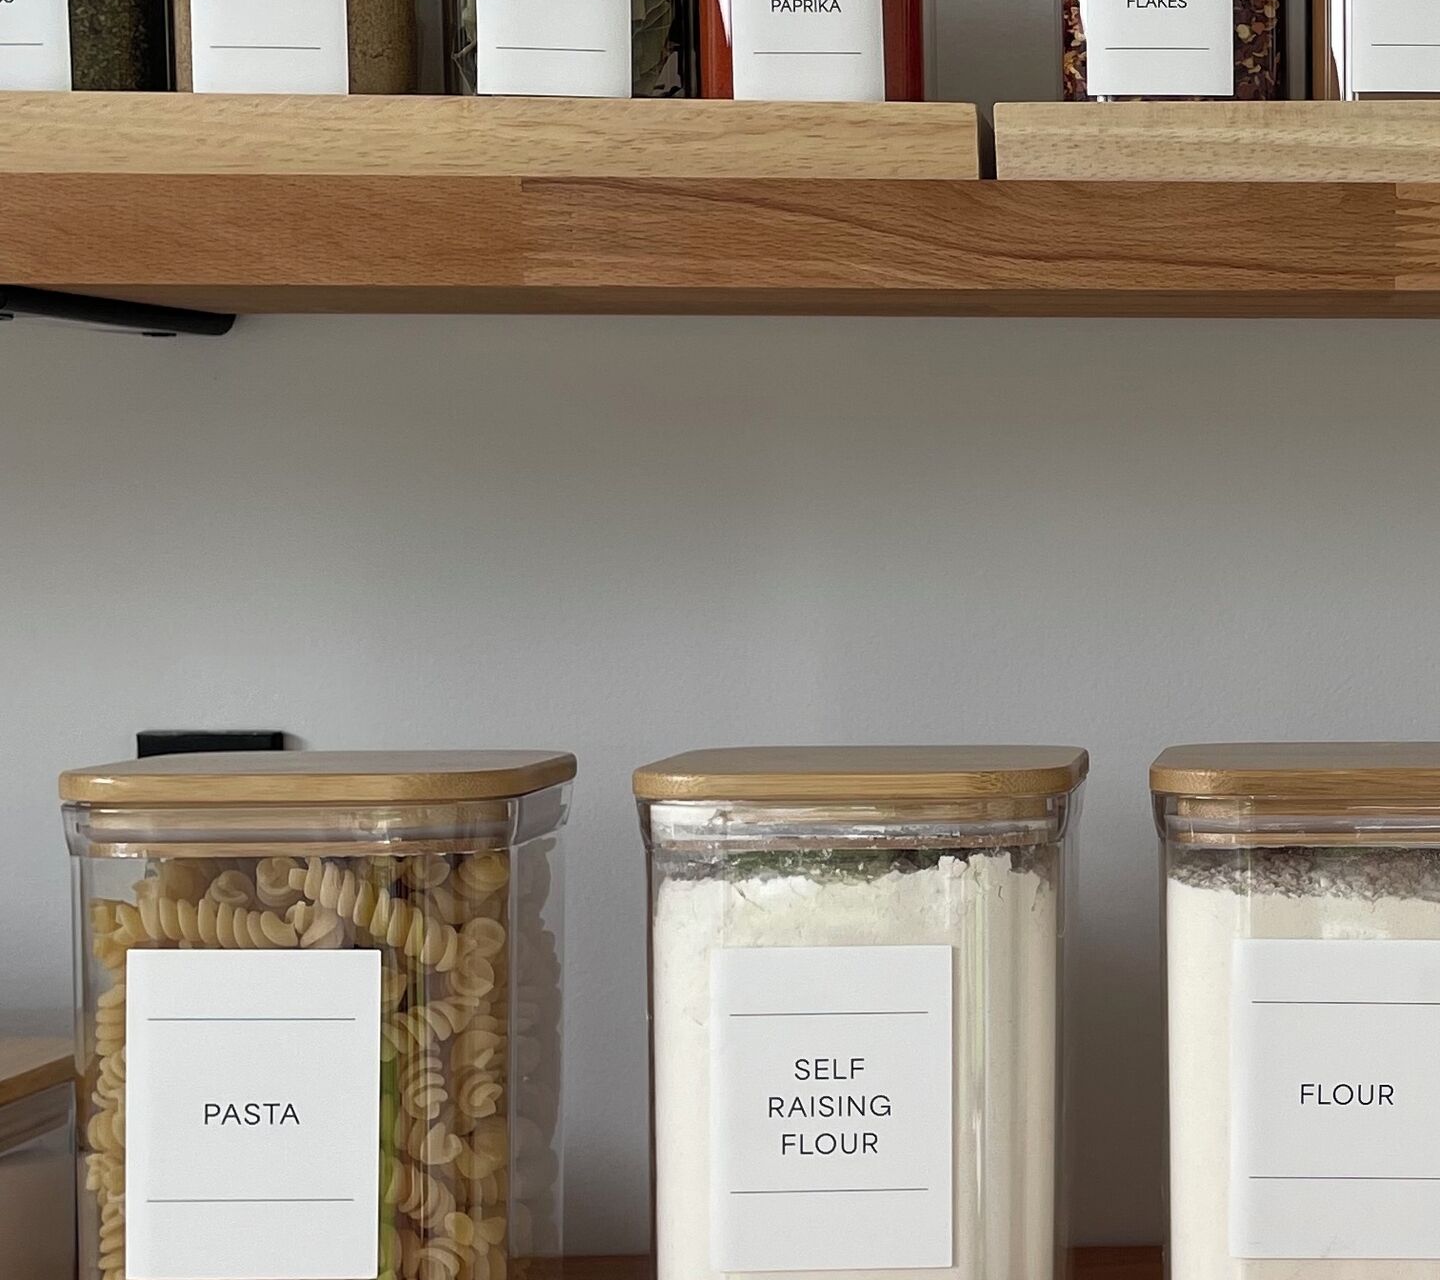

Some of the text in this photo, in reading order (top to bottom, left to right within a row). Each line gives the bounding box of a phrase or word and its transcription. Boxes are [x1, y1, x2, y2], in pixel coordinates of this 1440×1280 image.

[794, 1057, 865, 1081] SELF
[768, 1094, 892, 1119] RAISING
[1300, 1083, 1394, 1106] FLOUR
[204, 1102, 301, 1126] PASTA
[781, 1132, 878, 1156] FLOUR
